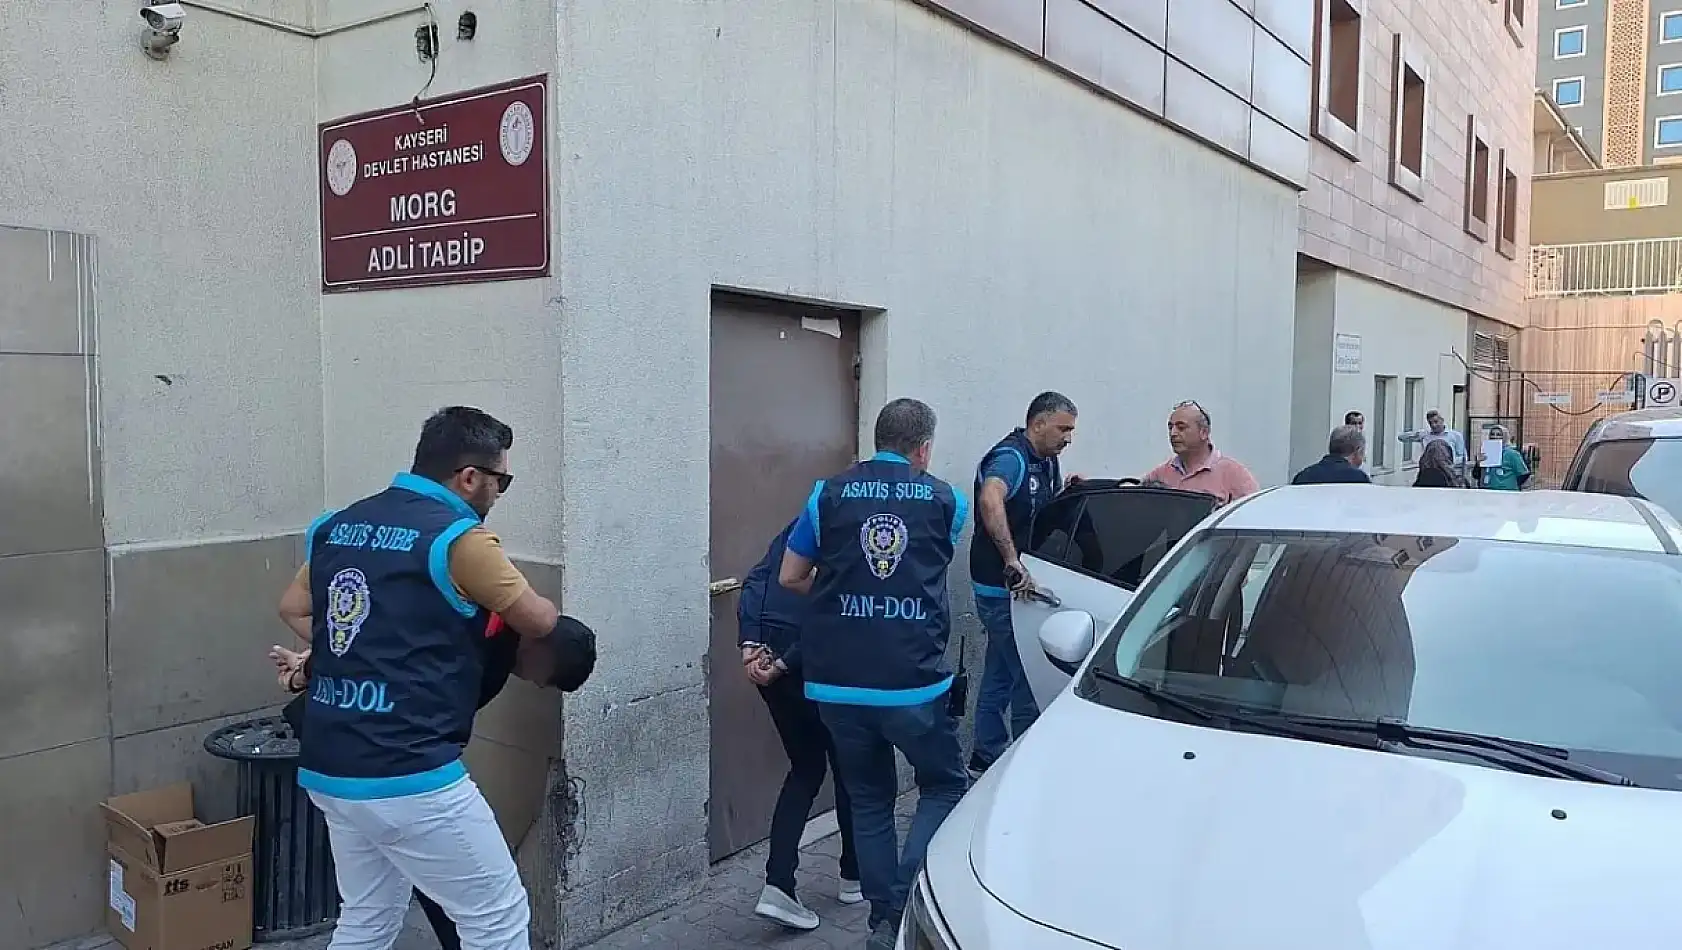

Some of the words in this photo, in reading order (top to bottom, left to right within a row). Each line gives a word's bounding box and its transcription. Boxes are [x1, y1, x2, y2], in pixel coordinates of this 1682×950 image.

[394, 124, 448, 151] KAYSERİ
[363, 157, 409, 178] DEVLET
[412, 140, 484, 169] HASTANESİ
[389, 189, 457, 222] MORG
[367, 237, 415, 272] ADLİ
[419, 231, 485, 267] TABİP
[841, 479, 889, 501] ASAYİŞ
[895, 482, 934, 502] ŞUBE
[326, 520, 369, 551] ASAYİŞ
[371, 525, 418, 551] ŞUBE
[838, 593, 927, 620] YAN-DOL
